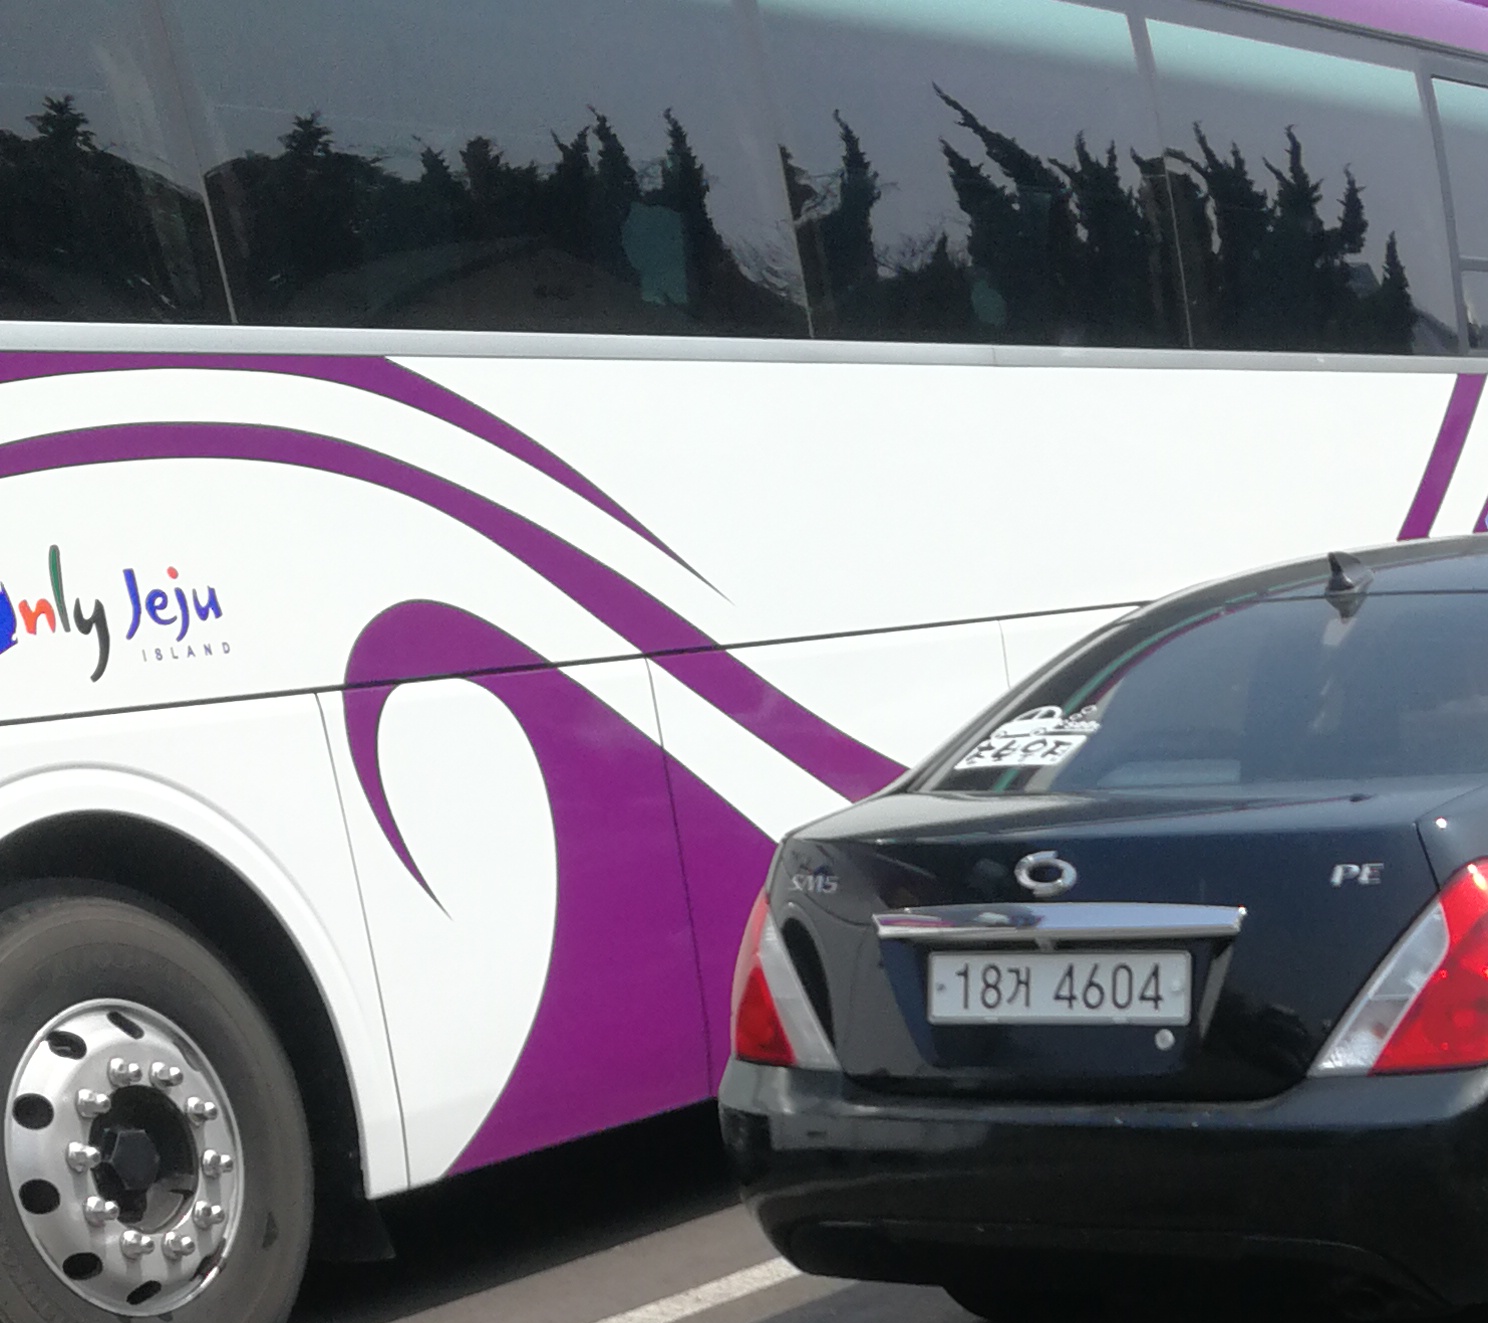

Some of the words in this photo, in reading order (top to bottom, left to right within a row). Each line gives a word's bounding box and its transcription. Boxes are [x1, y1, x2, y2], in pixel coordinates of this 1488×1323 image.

[122, 566, 222, 641] Jeju
[142, 641, 231, 662] ISLAND
[1330, 862, 1384, 888] PE
[955, 962, 1031, 1010] 18거
[1053, 962, 1164, 1011] 4604
